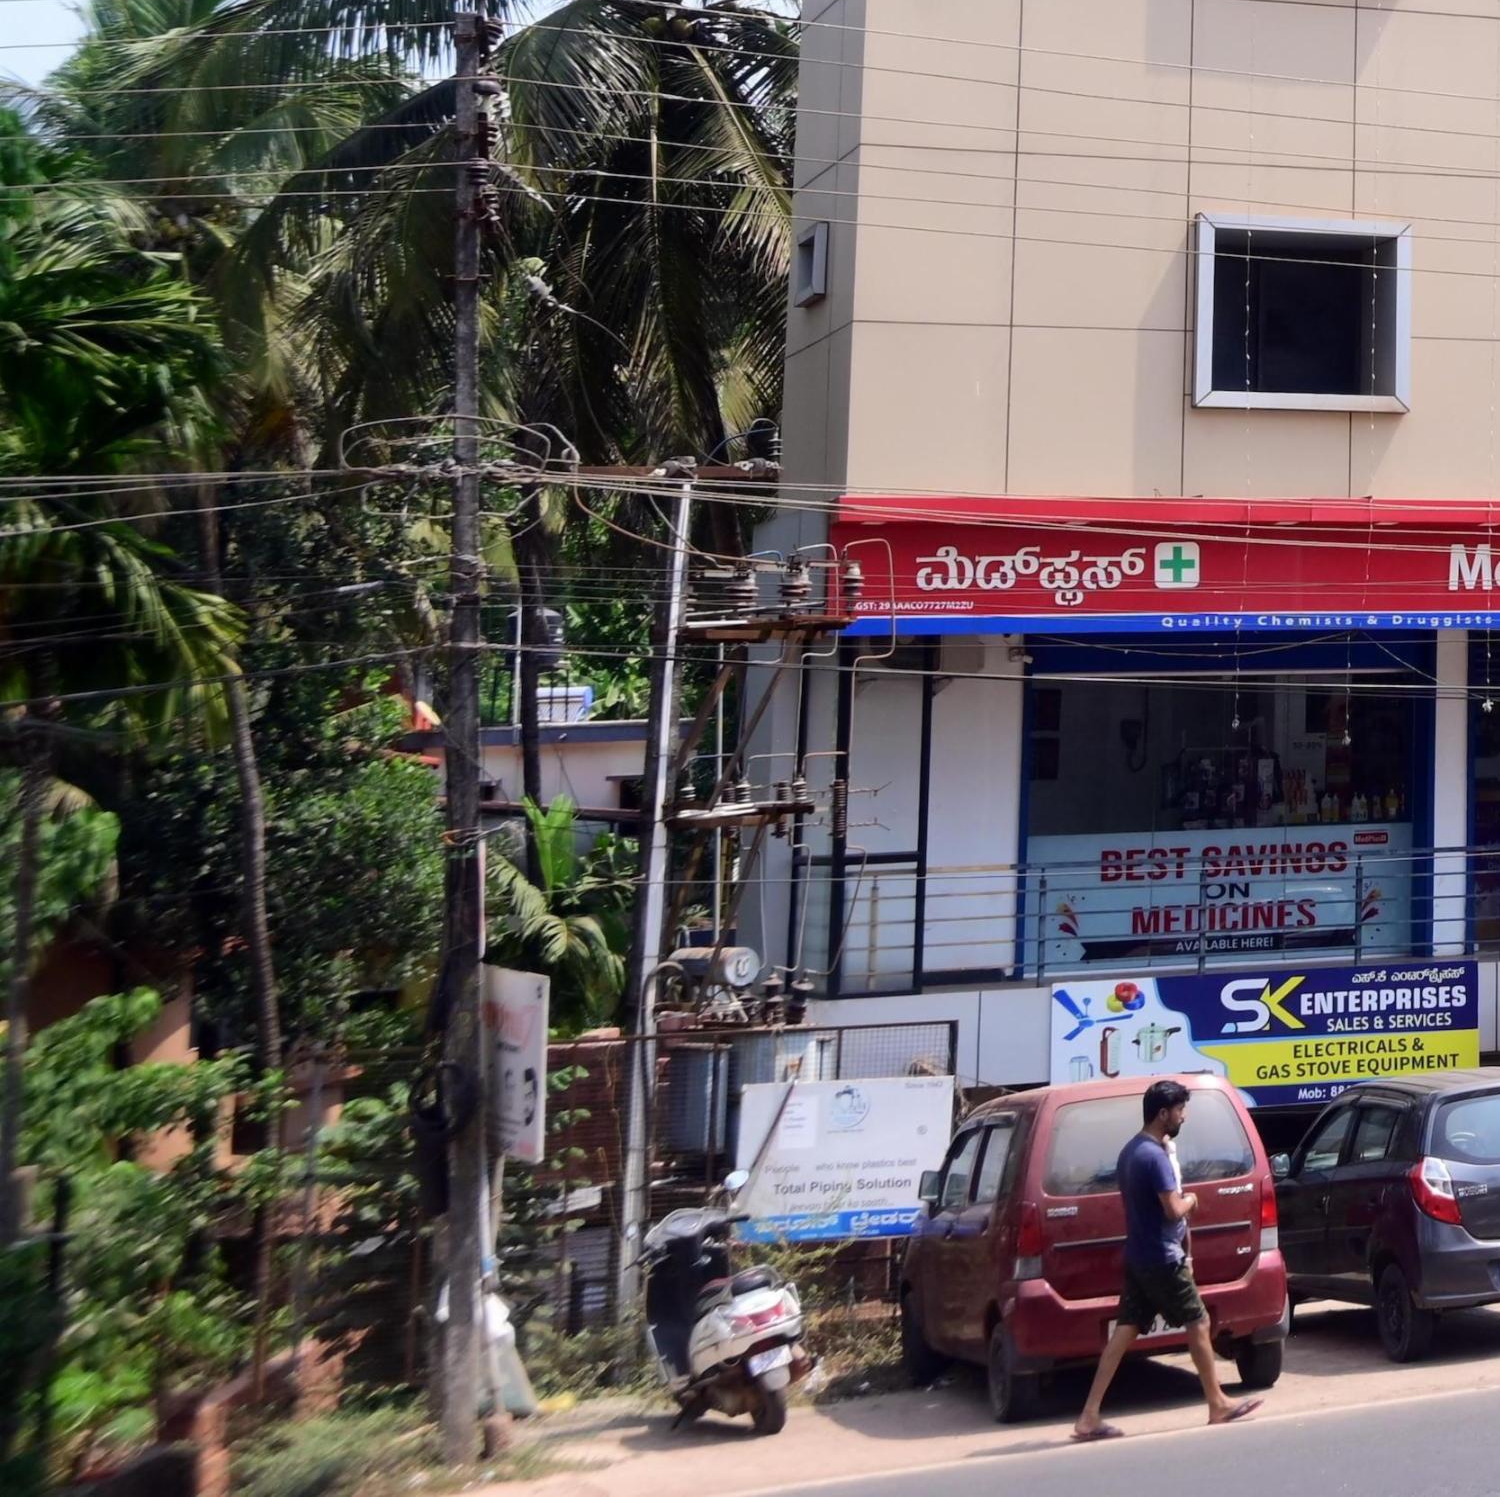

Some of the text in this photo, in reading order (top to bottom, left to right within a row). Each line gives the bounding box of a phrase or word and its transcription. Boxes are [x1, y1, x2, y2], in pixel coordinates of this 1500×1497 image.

[1162, 614, 1493, 629] Quality Chemists & Druggists
[1101, 841, 1348, 882] BEST SAVINGS
[1241, 937, 1274, 948] HERE!
[1220, 975, 1306, 1034] SK
[1300, 985, 1467, 1016] ENTERPRISES
[1326, 1012, 1452, 1032] SALES & SERVICES
[1293, 1037, 1424, 1059] ELECTRICALS &
[1256, 1053, 1460, 1080] GAS STOVE EQUIPMENT
[1298, 1087, 1326, 1100] Mob:
[765, 1158, 916, 1174] People who know plastics best
[774, 1177, 912, 1195] Total Piping Solution
